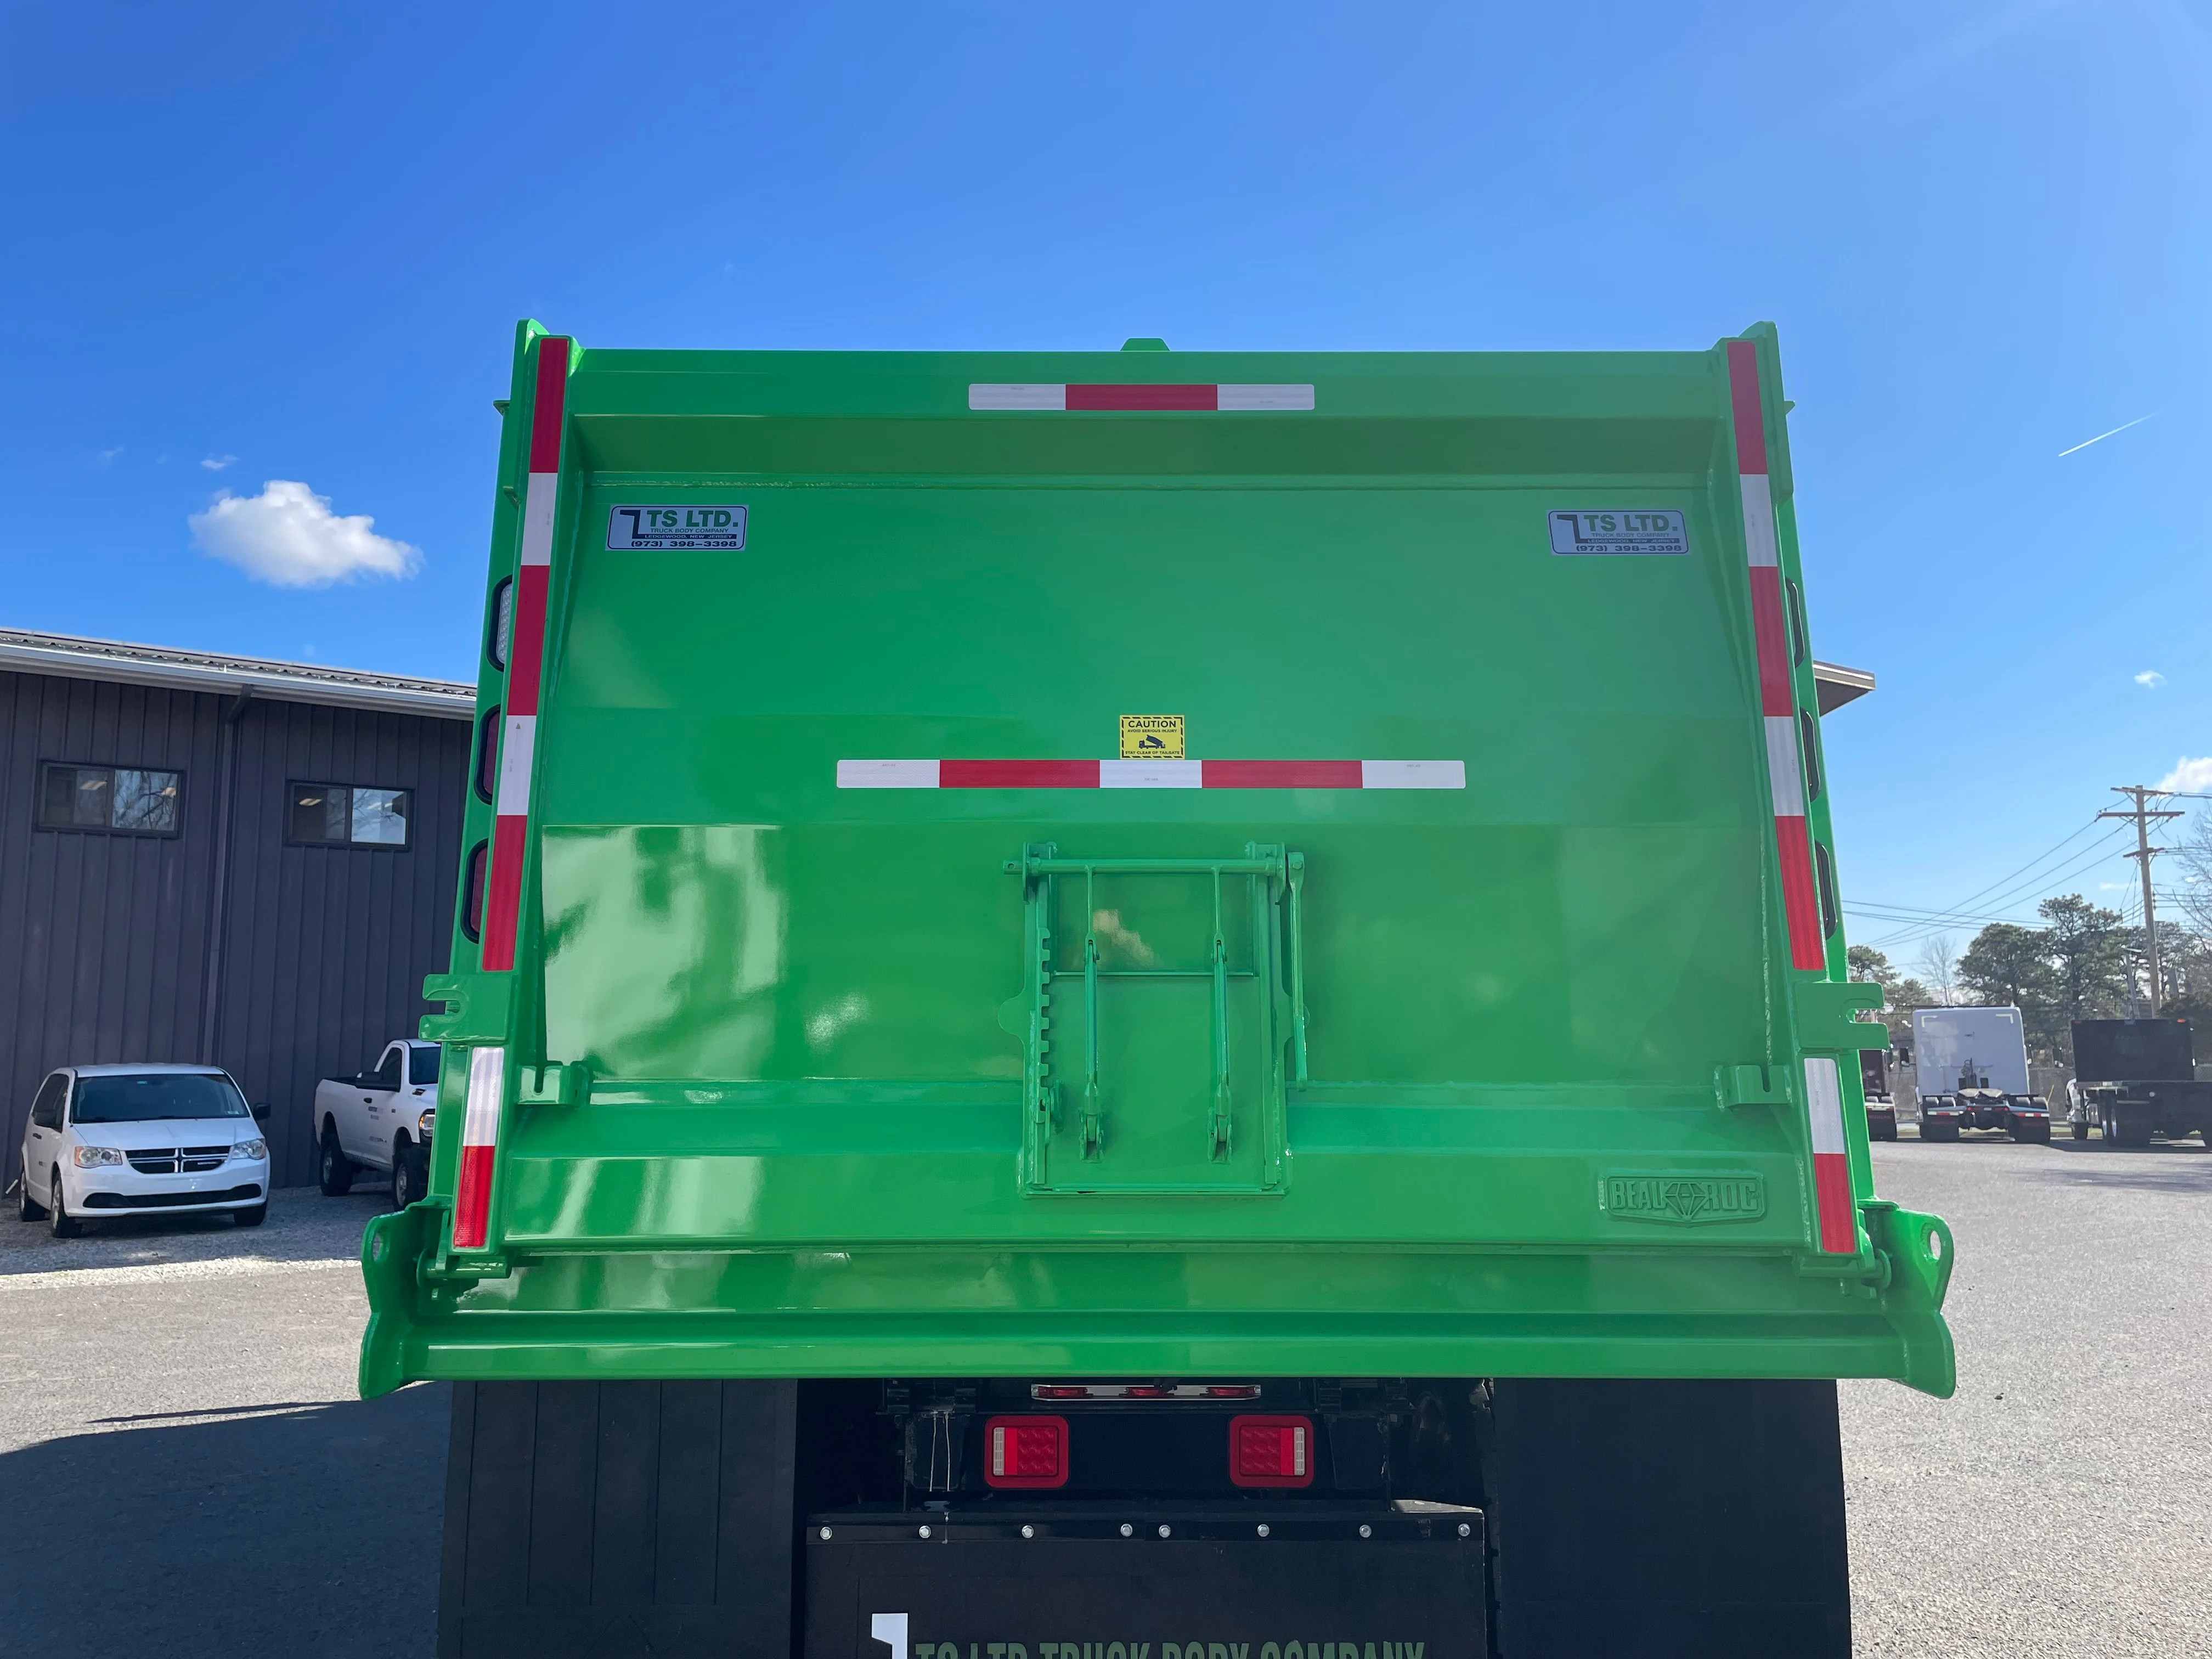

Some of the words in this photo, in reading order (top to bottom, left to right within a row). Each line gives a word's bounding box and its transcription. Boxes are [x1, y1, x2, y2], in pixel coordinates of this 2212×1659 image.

[646, 510, 678, 527] TS
[686, 510, 738, 527] LTD.
[1583, 515, 1617, 532] TS
[1623, 515, 1678, 532] LTD.
